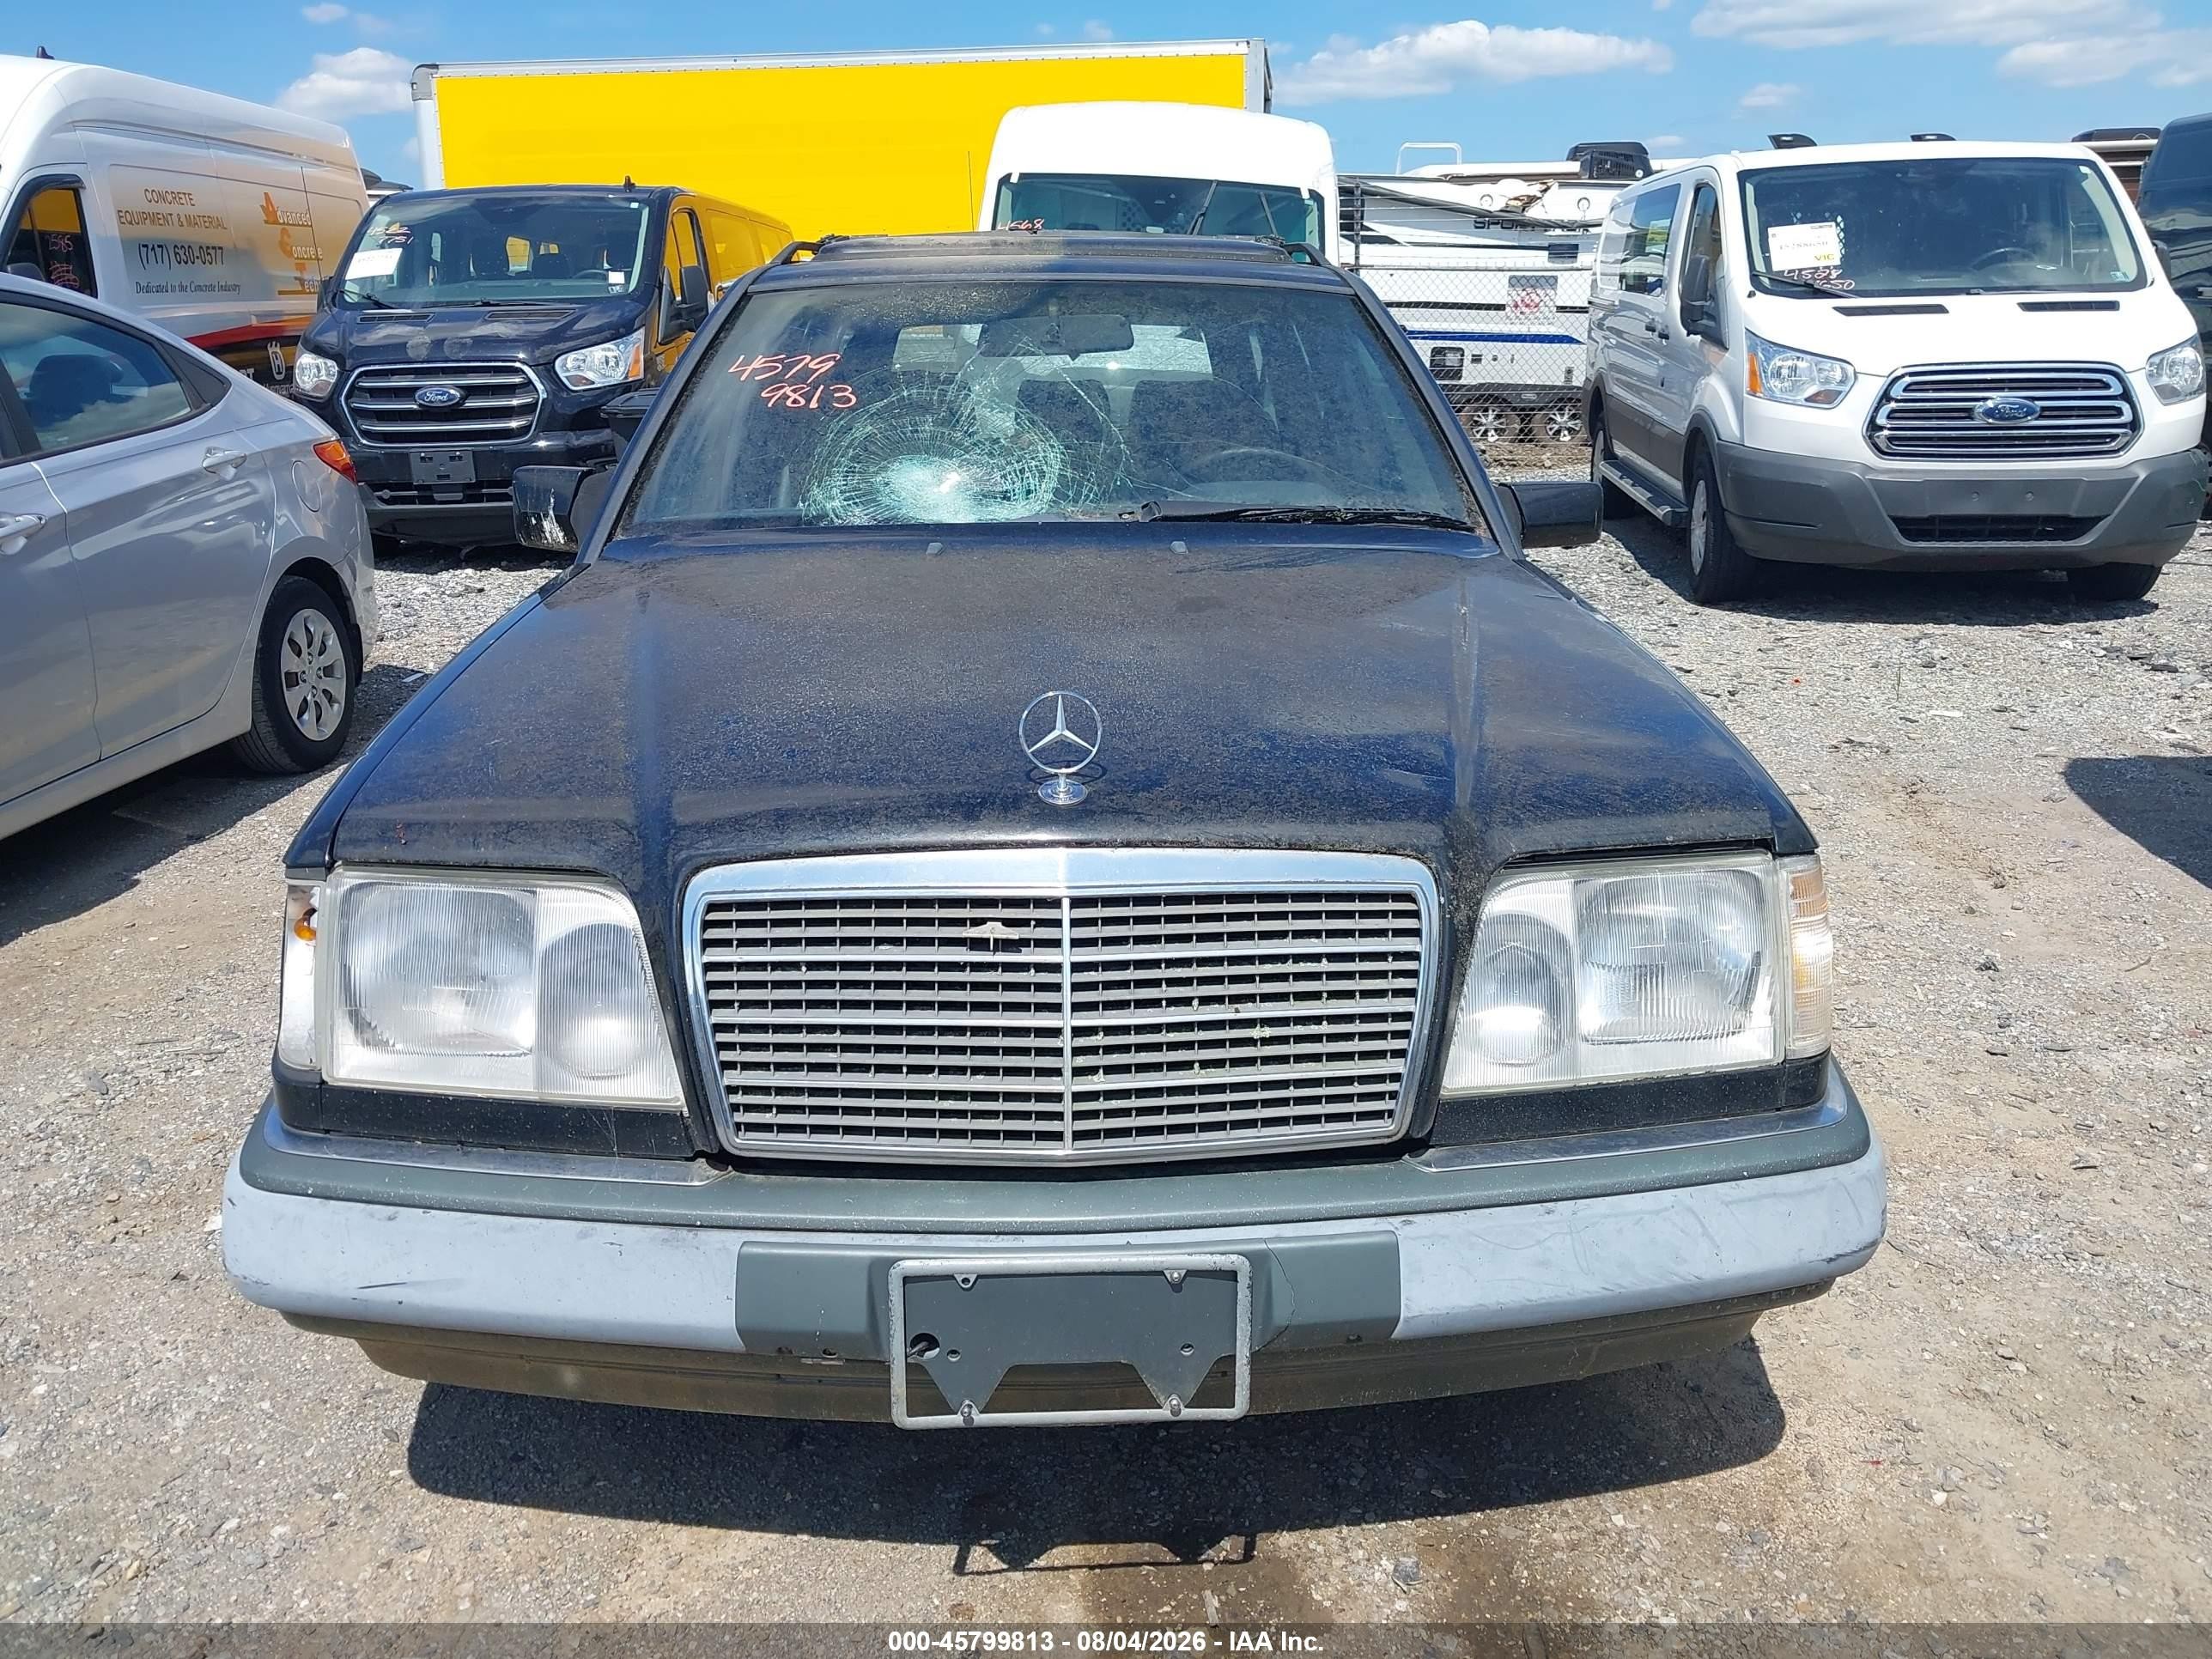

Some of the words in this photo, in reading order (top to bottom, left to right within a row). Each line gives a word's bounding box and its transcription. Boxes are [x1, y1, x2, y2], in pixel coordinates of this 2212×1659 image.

[144, 188, 196, 206] CONCRETE
[117, 210, 174, 228] EQUIPMENT
[177, 213, 185, 228] &
[185, 214, 228, 230] MATERIAL
[138, 242, 171, 270] (717)
[173, 244, 224, 265] 630-0577
[136, 281, 169, 294] Dedicated
[170, 283, 177, 293] to
[178, 281, 188, 293] the
[189, 281, 216, 293] Concrete
[217, 281, 241, 295] Industry
[727, 353, 842, 384] 4579
[424, 391, 449, 402] Ford
[761, 383, 857, 409] 9813
[1995, 404, 2027, 418] Ford
